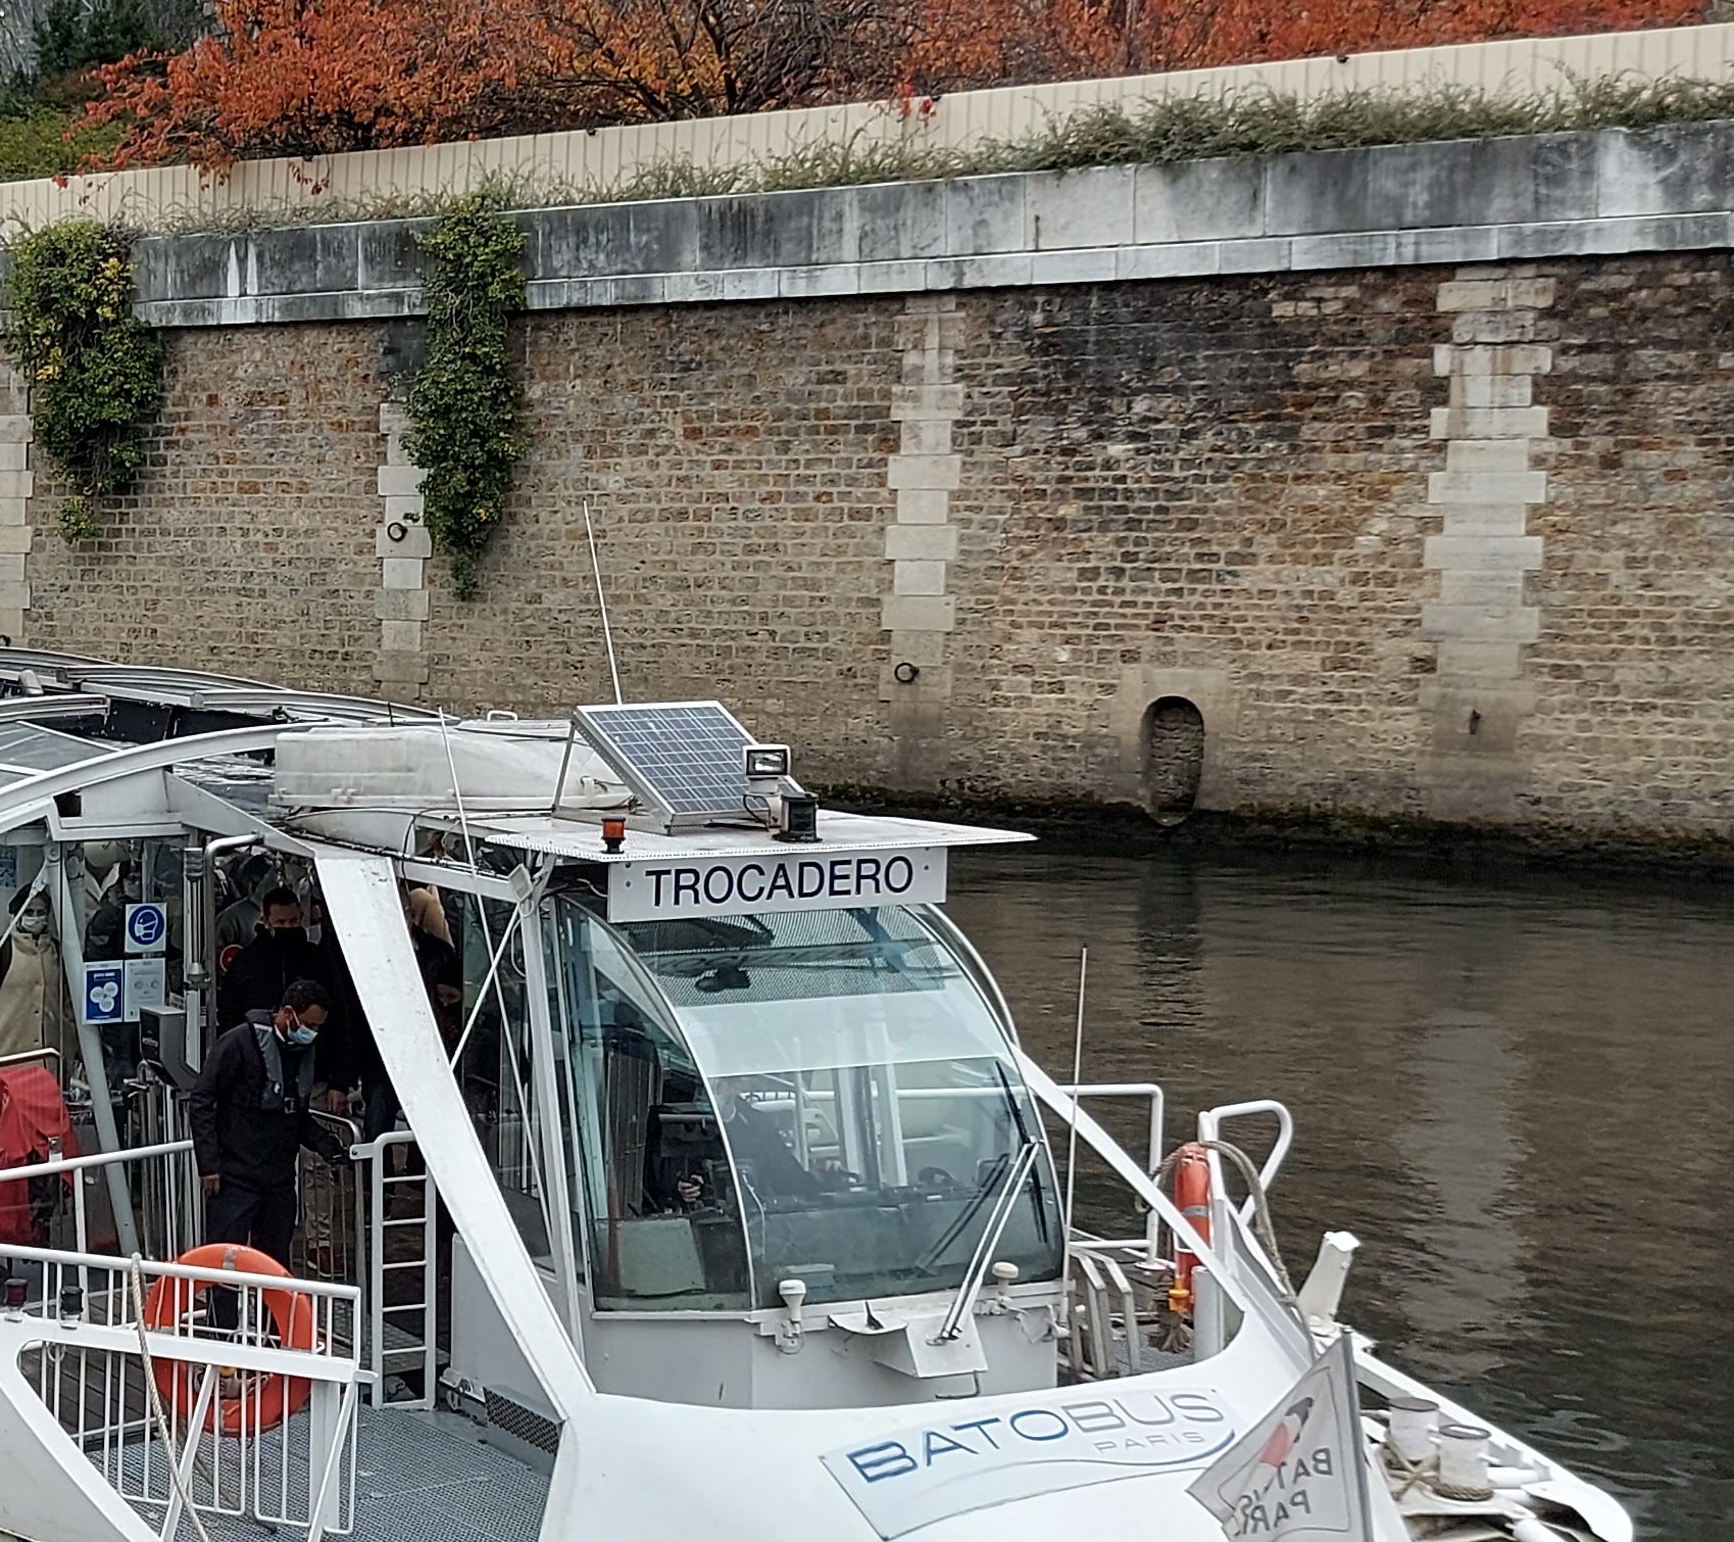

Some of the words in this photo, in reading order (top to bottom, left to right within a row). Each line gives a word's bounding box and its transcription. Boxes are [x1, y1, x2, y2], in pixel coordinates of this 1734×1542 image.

[645, 856, 914, 906] TROCADERO
[846, 1393, 1224, 1483] BATOBUS
[1093, 1430, 1205, 1455] PARIS
